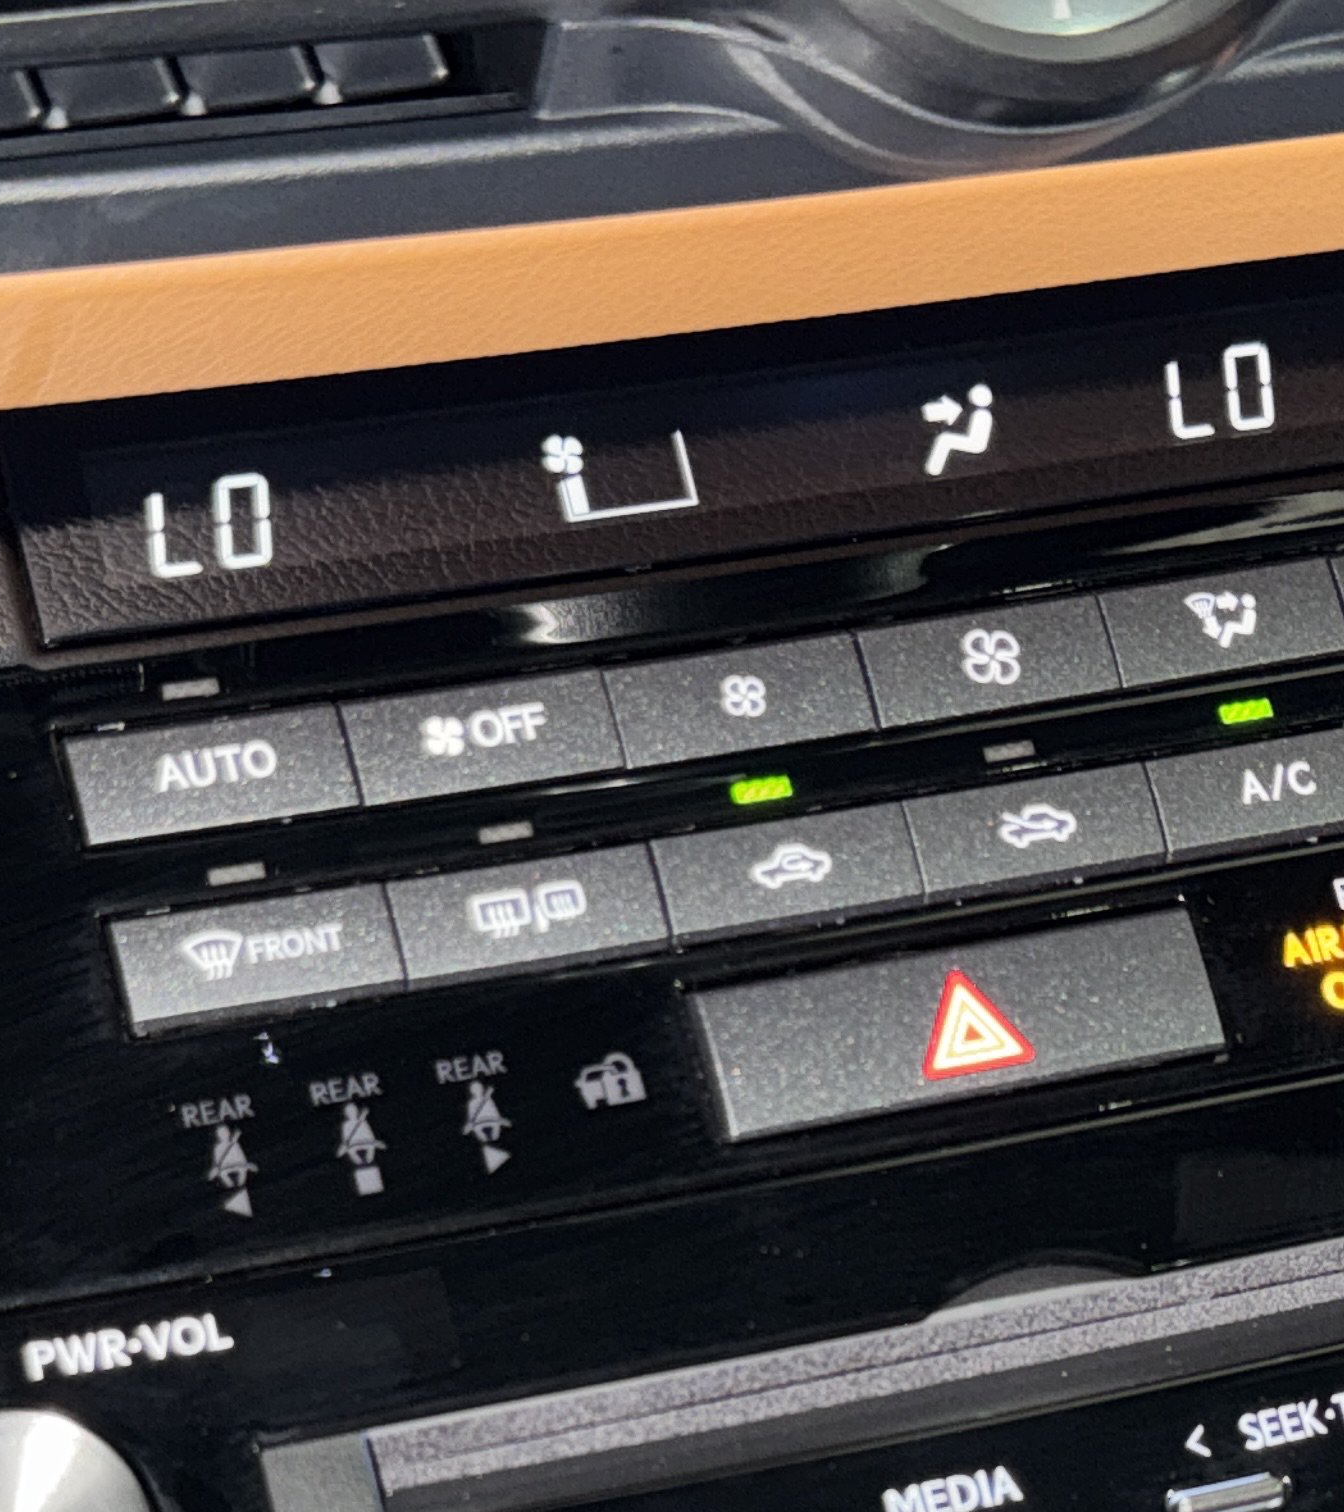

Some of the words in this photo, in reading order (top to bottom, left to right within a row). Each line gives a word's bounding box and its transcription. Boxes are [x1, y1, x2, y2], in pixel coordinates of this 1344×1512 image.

[1166, 342, 1275, 440] LO
[145, 471, 273, 579] LO
[469, 702, 547, 748] OFF
[156, 741, 277, 793] AUTO
[1241, 761, 1317, 805] A/C
[247, 922, 343, 964] FRONT
[309, 1073, 381, 1106] REAR
[436, 1051, 506, 1085] REAR
[180, 1095, 253, 1130] REAR
